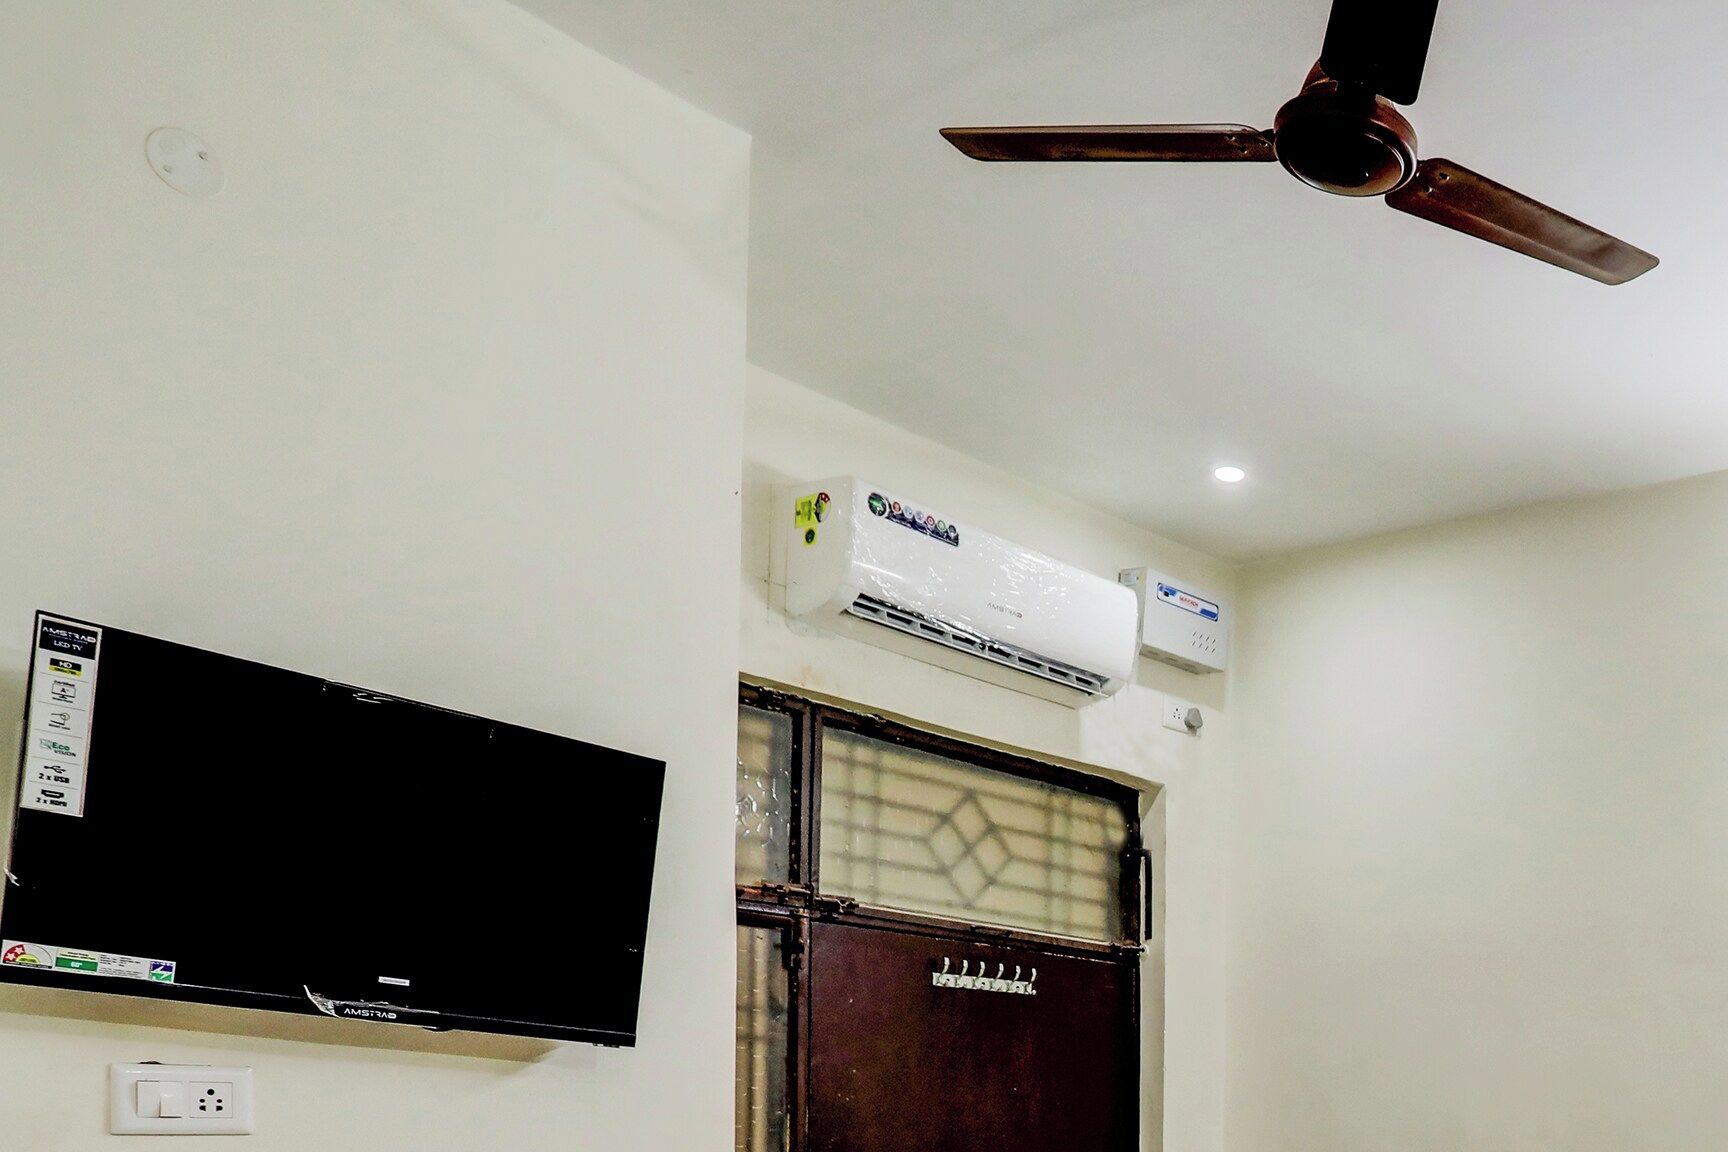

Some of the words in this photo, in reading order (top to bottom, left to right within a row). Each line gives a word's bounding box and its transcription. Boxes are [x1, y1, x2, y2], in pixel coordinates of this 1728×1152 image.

[42, 627, 96, 643] AMSTRAD
[53, 640, 70, 648] LED
[52, 742, 70, 751] Eco
[53, 775, 70, 783] USB
[344, 1008, 397, 1019] AMSTRAD
